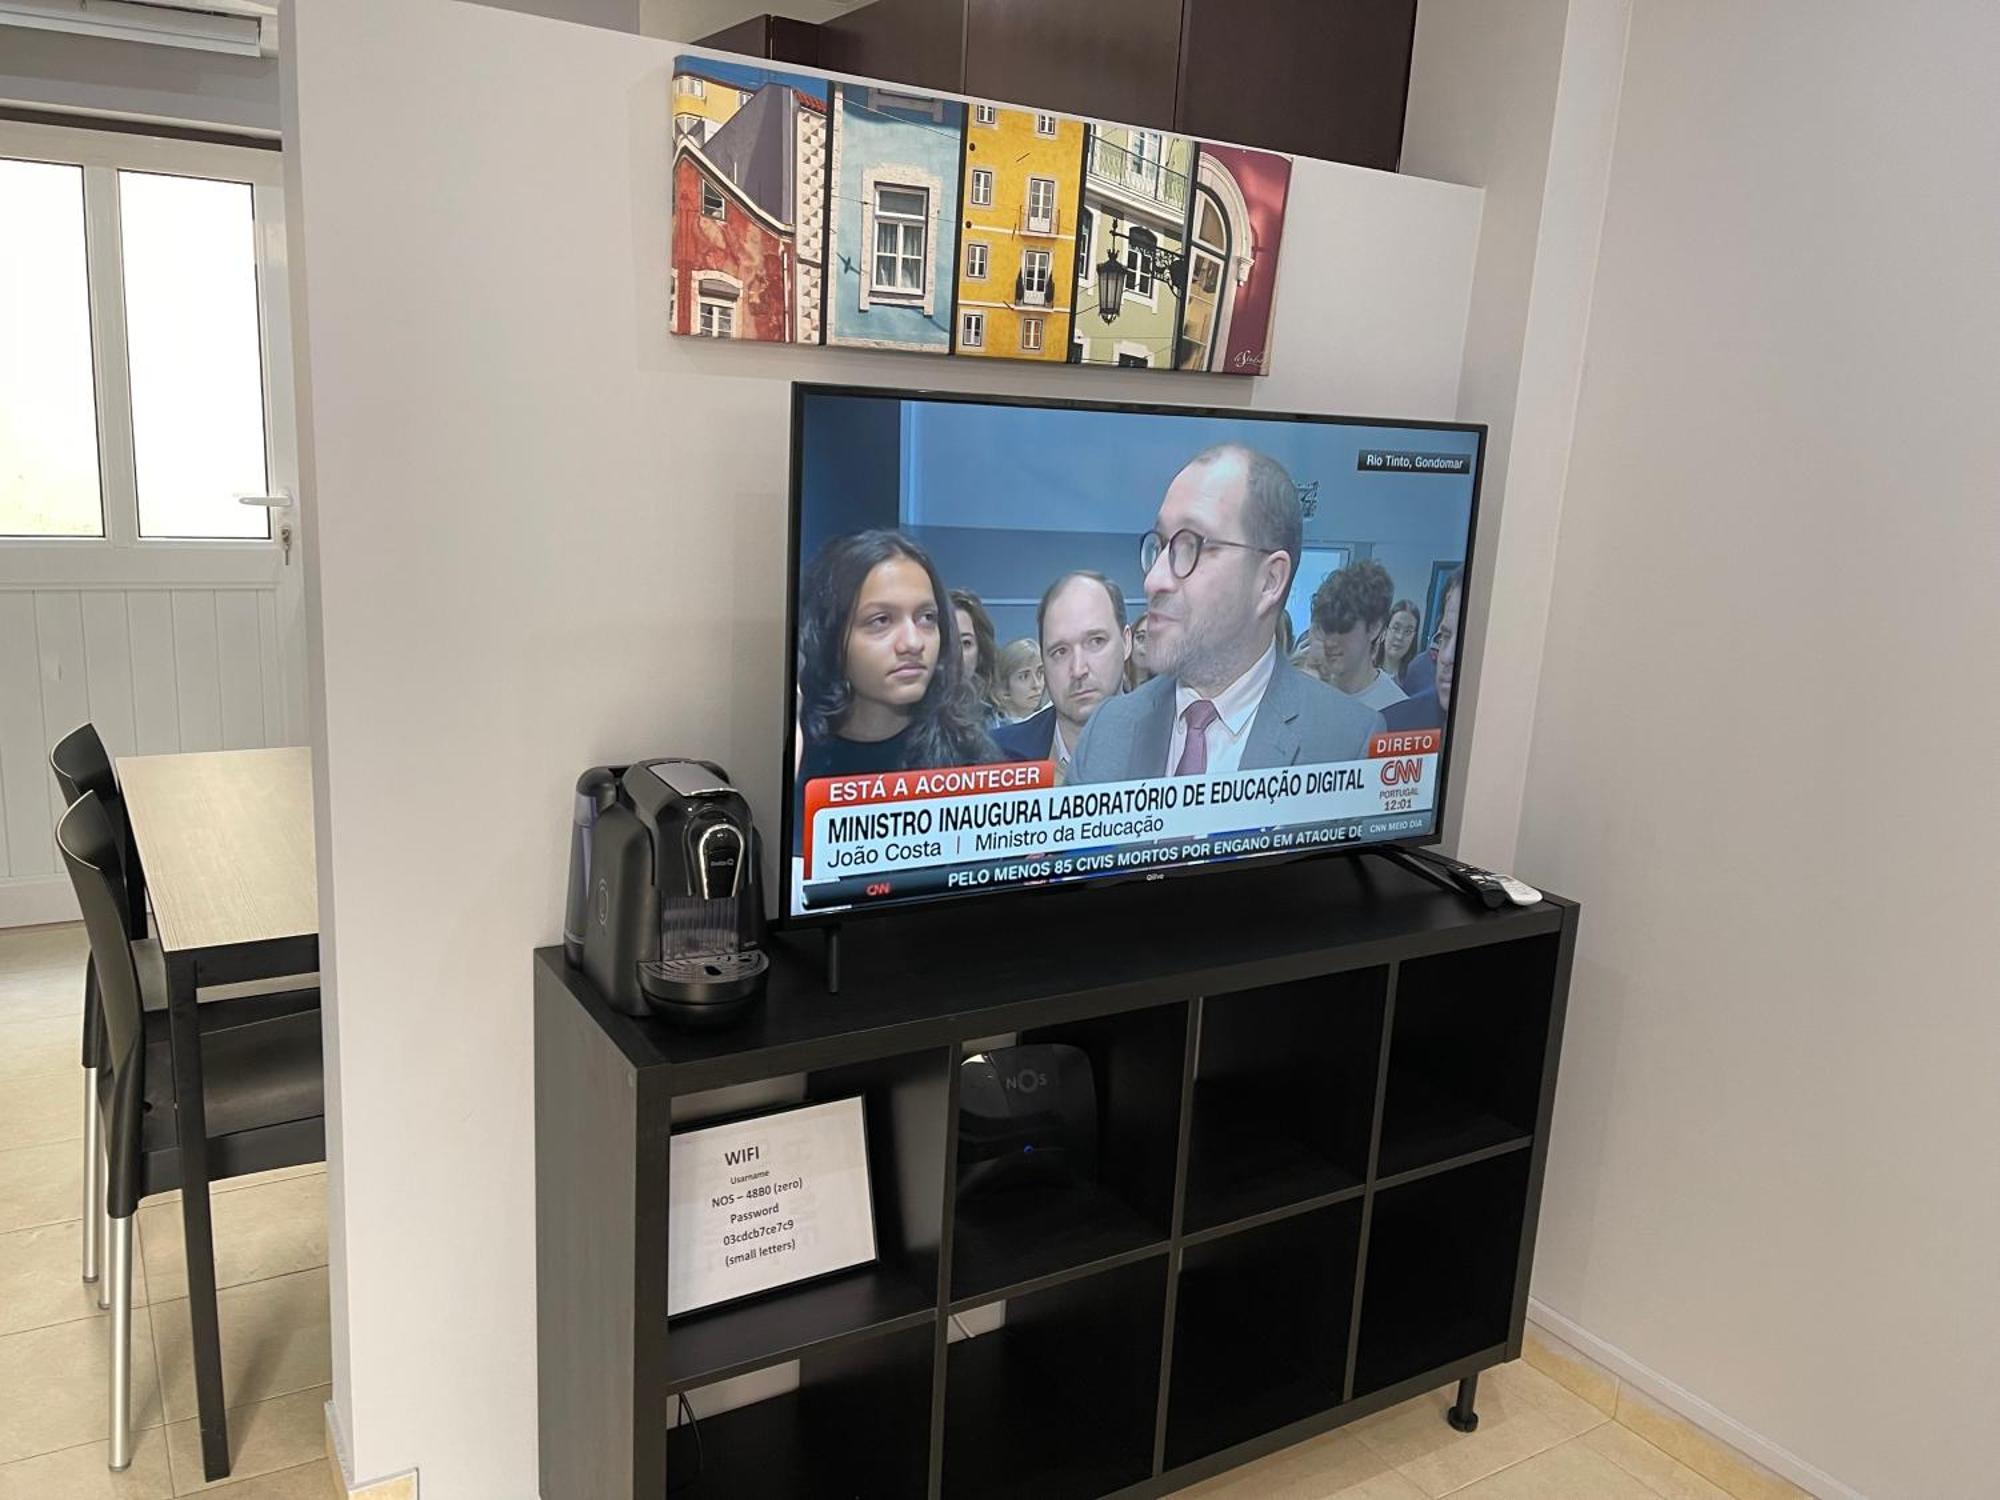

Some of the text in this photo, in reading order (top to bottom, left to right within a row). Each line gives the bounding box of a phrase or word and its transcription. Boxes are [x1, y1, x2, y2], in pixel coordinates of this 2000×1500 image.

[1366, 454, 1463, 469] Rio Tinto, Gondomar
[1376, 736, 1432, 753] DIRETO
[1380, 758, 1423, 786] CNN
[829, 767, 1040, 802] ESTÁ A ACONTECER
[1380, 788, 1418, 799] PORTUGAL
[828, 768, 1364, 844] MINISTRO INAUGURA LABORATÓRIO DE EDUCAÇÃO DIGITAL
[1384, 799, 1412, 811] 12:01
[975, 815, 1164, 851] Ministro da Educação
[1370, 824, 1387, 833] CNN
[827, 841, 941, 868] João Costa
[948, 869, 990, 887] PELO
[994, 863, 1050, 881] MENOS
[1054, 859, 1072, 874] 85
[1076, 854, 1114, 871] CIVIS
[1118, 847, 1178, 867] MORTOS
[1182, 843, 1210, 859] POR
[1214, 837, 1270, 855] ENGANO
[1273, 834, 1293, 848] EM
[1296, 827, 1345, 845] ATAQUE
[866, 883, 890, 895] CNN
[724, 1146, 760, 1166] WIFI
[730, 1169, 770, 1185] Username
[711, 1194, 735, 1209] NOS
[774, 1177, 803, 1195] (zero)
[730, 1203, 780, 1224] Password
[723, 1219, 795, 1246] 03cdcb7ce7c9
[725, 1239, 796, 1268] (small letters)
